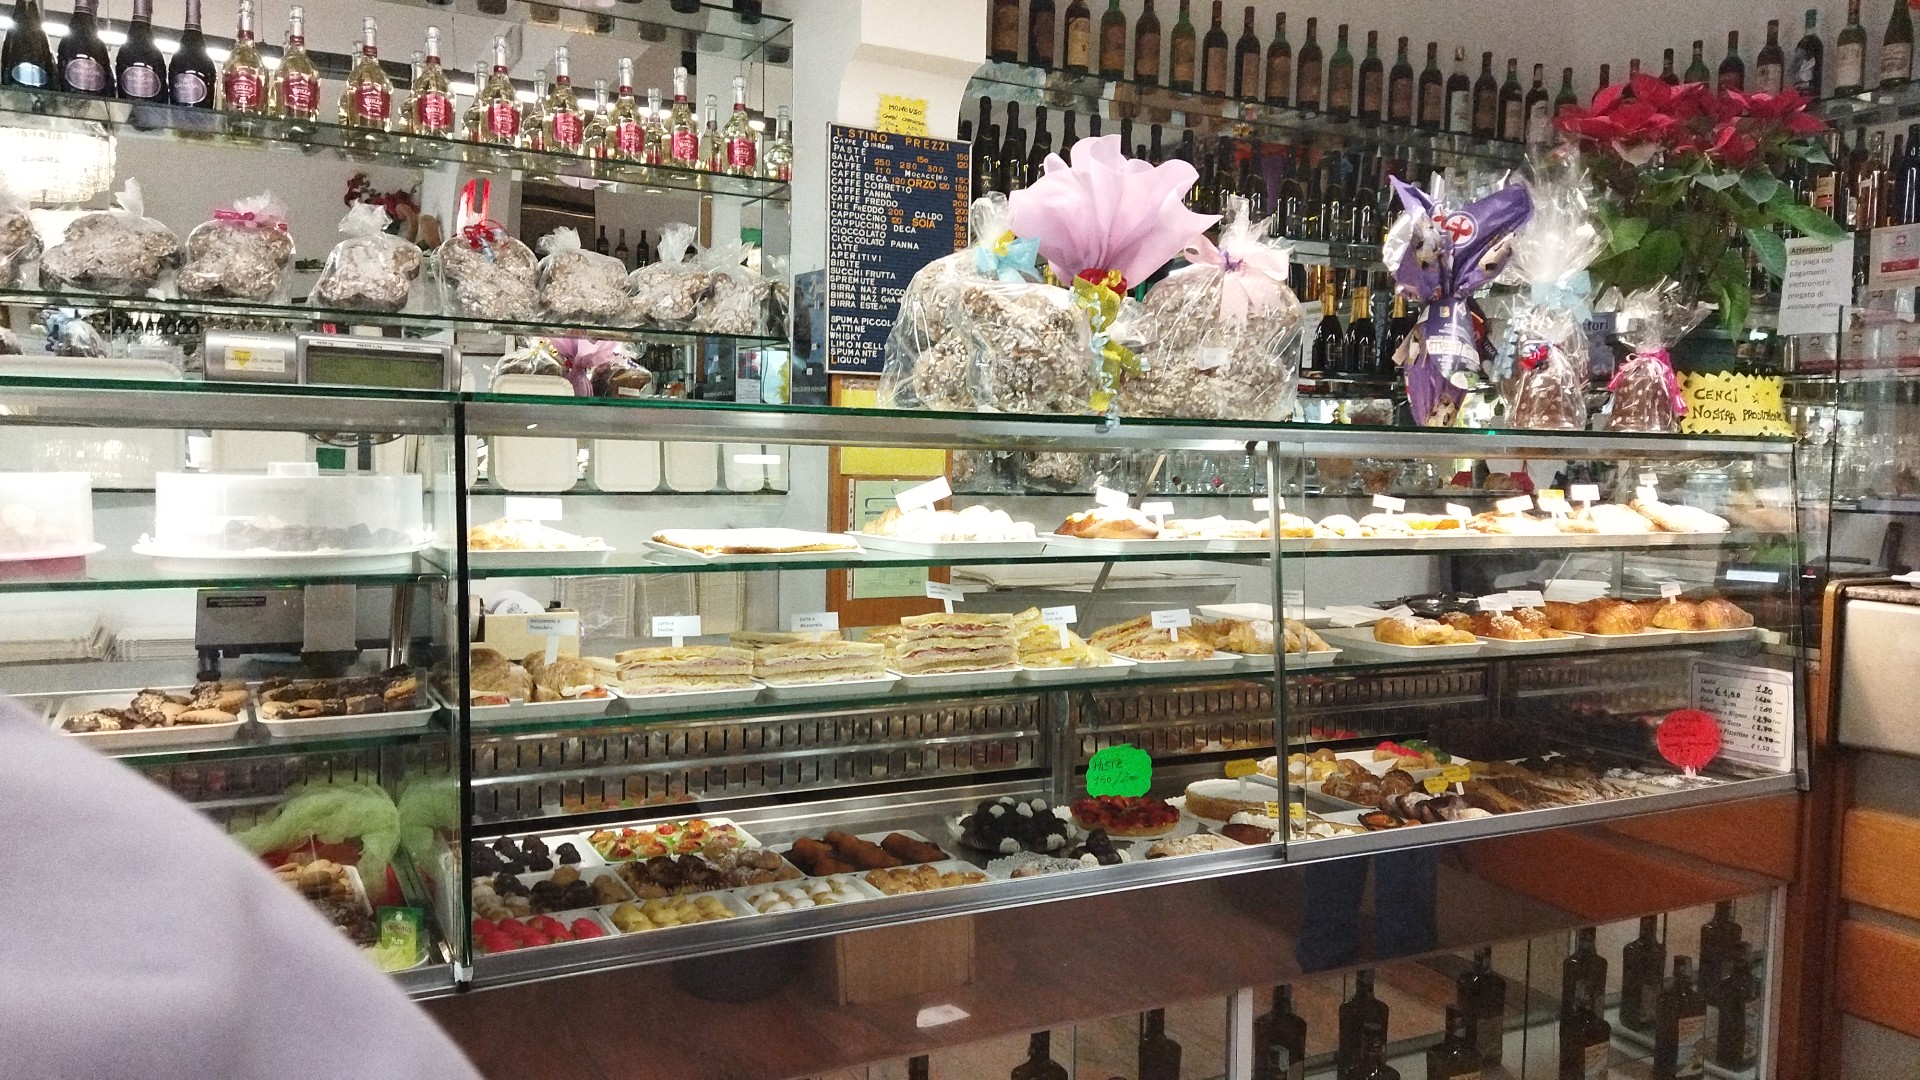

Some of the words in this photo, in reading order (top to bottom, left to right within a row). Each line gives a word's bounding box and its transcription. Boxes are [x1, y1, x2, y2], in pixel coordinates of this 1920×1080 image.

[889, 104, 922, 115] MONOUSO
[906, 137, 949, 151] PREZZI
[834, 144, 866, 156] PASTE
[831, 152, 866, 163] SALATI
[900, 162, 917, 170] 280
[832, 161, 861, 171] CAFFE
[831, 169, 861, 179] CAFFE
[864, 173, 888, 182] DECA
[907, 179, 936, 189] ORZO
[832, 177, 861, 187] CAFFE
[864, 181, 912, 194] CORRETTO
[831, 185, 860, 195] CAFFE
[864, 189, 891, 199] PANNA
[953, 200, 967, 208] 200
[831, 194, 860, 203] CAFFE
[865, 197, 898, 207] FREDDO
[831, 202, 849, 210] THE
[853, 204, 884, 214] FREDDO
[915, 211, 943, 221] CALDO
[831, 210, 887, 222] CAPPUCCINO
[912, 218, 935, 229] SOIA
[831, 218, 887, 231] CAPPUCCINO
[893, 224, 916, 234] DECA
[831, 227, 886, 239] CIOCCOLATO
[832, 234, 884, 246] CIOCCOLATO
[891, 240, 919, 250] PANNA
[832, 243, 858, 252] LATTE
[831, 251, 881, 262] APERITIVI
[831, 259, 860, 268] BIBITE
[830, 268, 863, 276] SUCCHI
[865, 270, 896, 280] FRUTTA
[830, 276, 875, 285] SPREMUTE
[831, 283, 856, 292] BIRRA
[860, 285, 877, 294] NAZ
[831, 292, 855, 300] BIRRA
[860, 294, 877, 303] NAZ
[831, 300, 856, 309] BIRRA
[831, 316, 859, 324] SPUMA
[831, 324, 865, 333] LATTINE
[830, 332, 861, 341] WHISKY
[831, 340, 886, 350] LIMONCELL
[830, 348, 877, 358] SPUMANTE
[1693, 405, 1736, 424] NOSTRA
